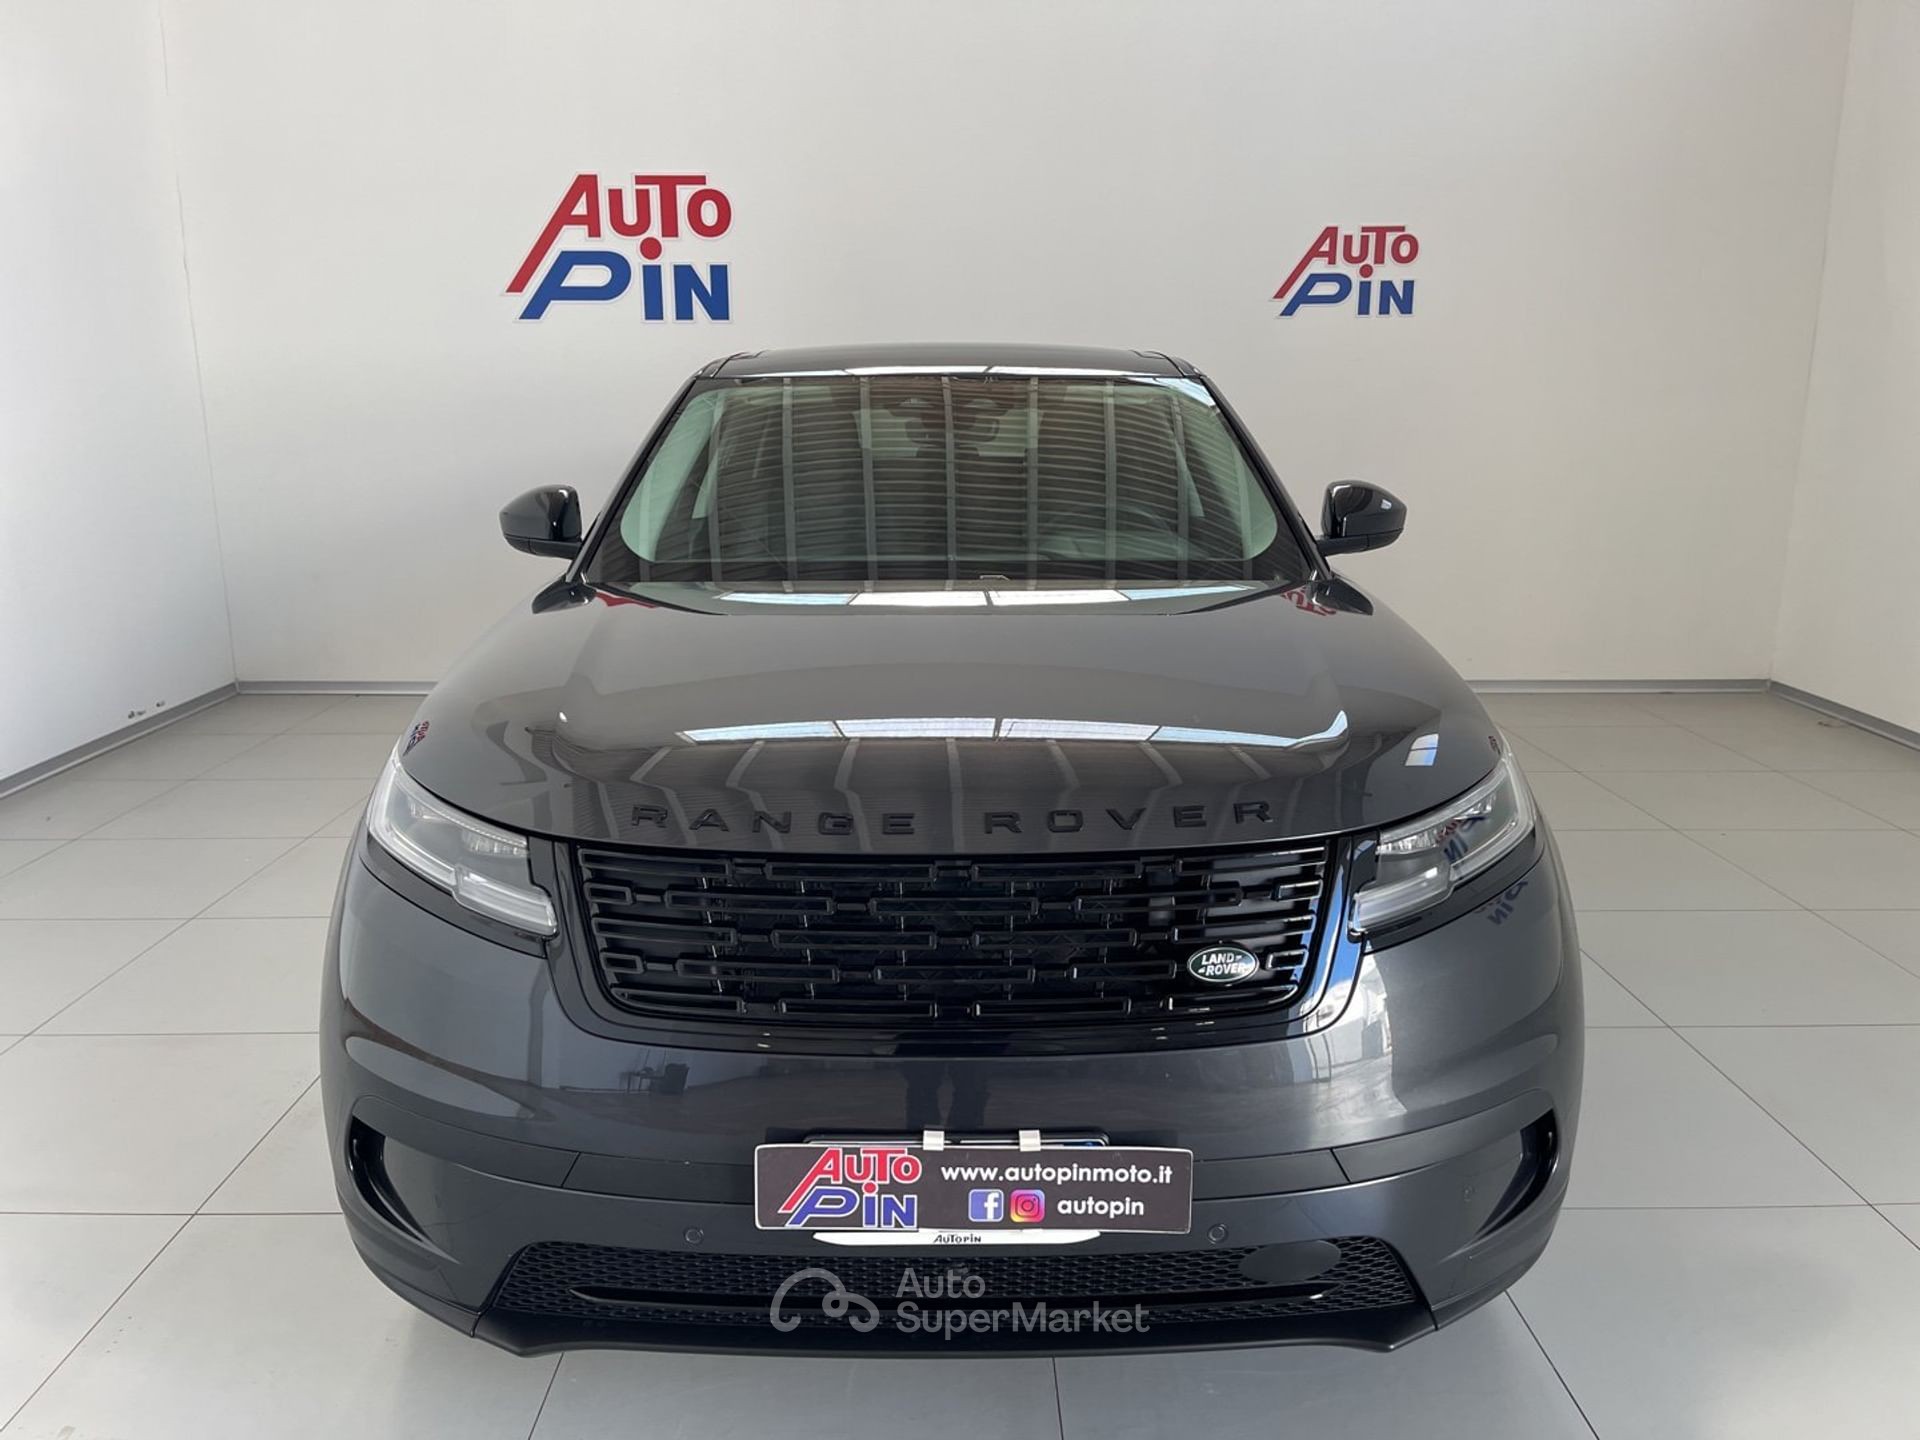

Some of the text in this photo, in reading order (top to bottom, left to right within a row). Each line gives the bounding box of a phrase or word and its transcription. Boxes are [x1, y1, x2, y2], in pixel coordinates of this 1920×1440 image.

[631, 800, 1274, 836] RANGE ROVER
[1201, 953, 1235, 966] LAND
[1205, 962, 1247, 977] ROVER
[940, 1163, 1174, 1185] www.autopinmoto.it
[1056, 1196, 1145, 1219] autopin
